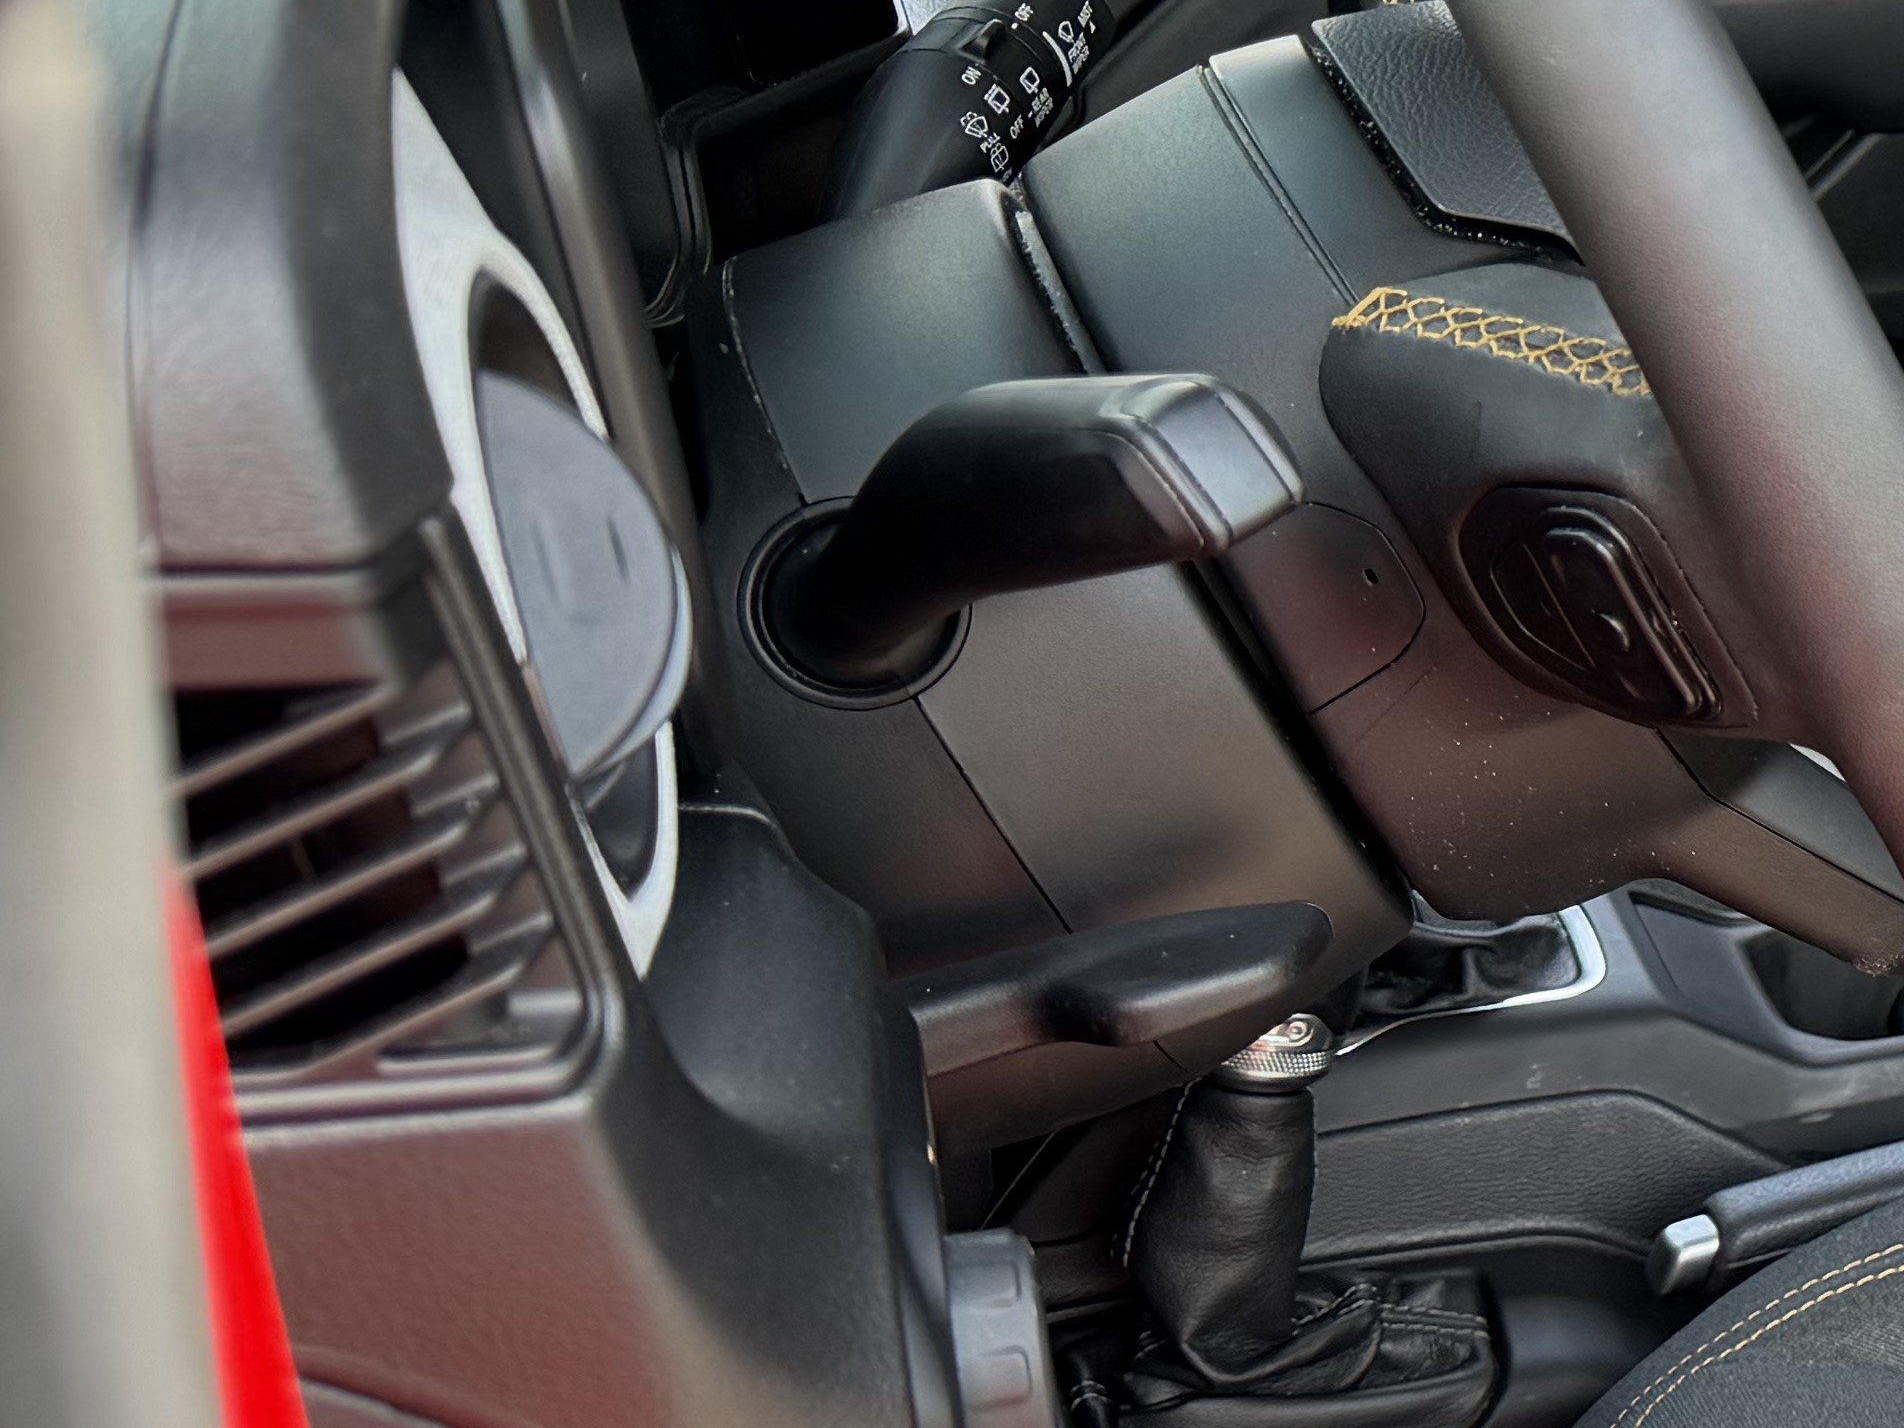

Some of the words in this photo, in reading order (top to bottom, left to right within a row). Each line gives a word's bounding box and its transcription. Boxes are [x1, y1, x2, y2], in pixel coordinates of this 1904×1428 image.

[1015, 2, 1034, 22] OFF
[961, 66, 981, 85] ON
[1010, 114, 1024, 139] OFF
[980, 132, 1001, 153] PULL
